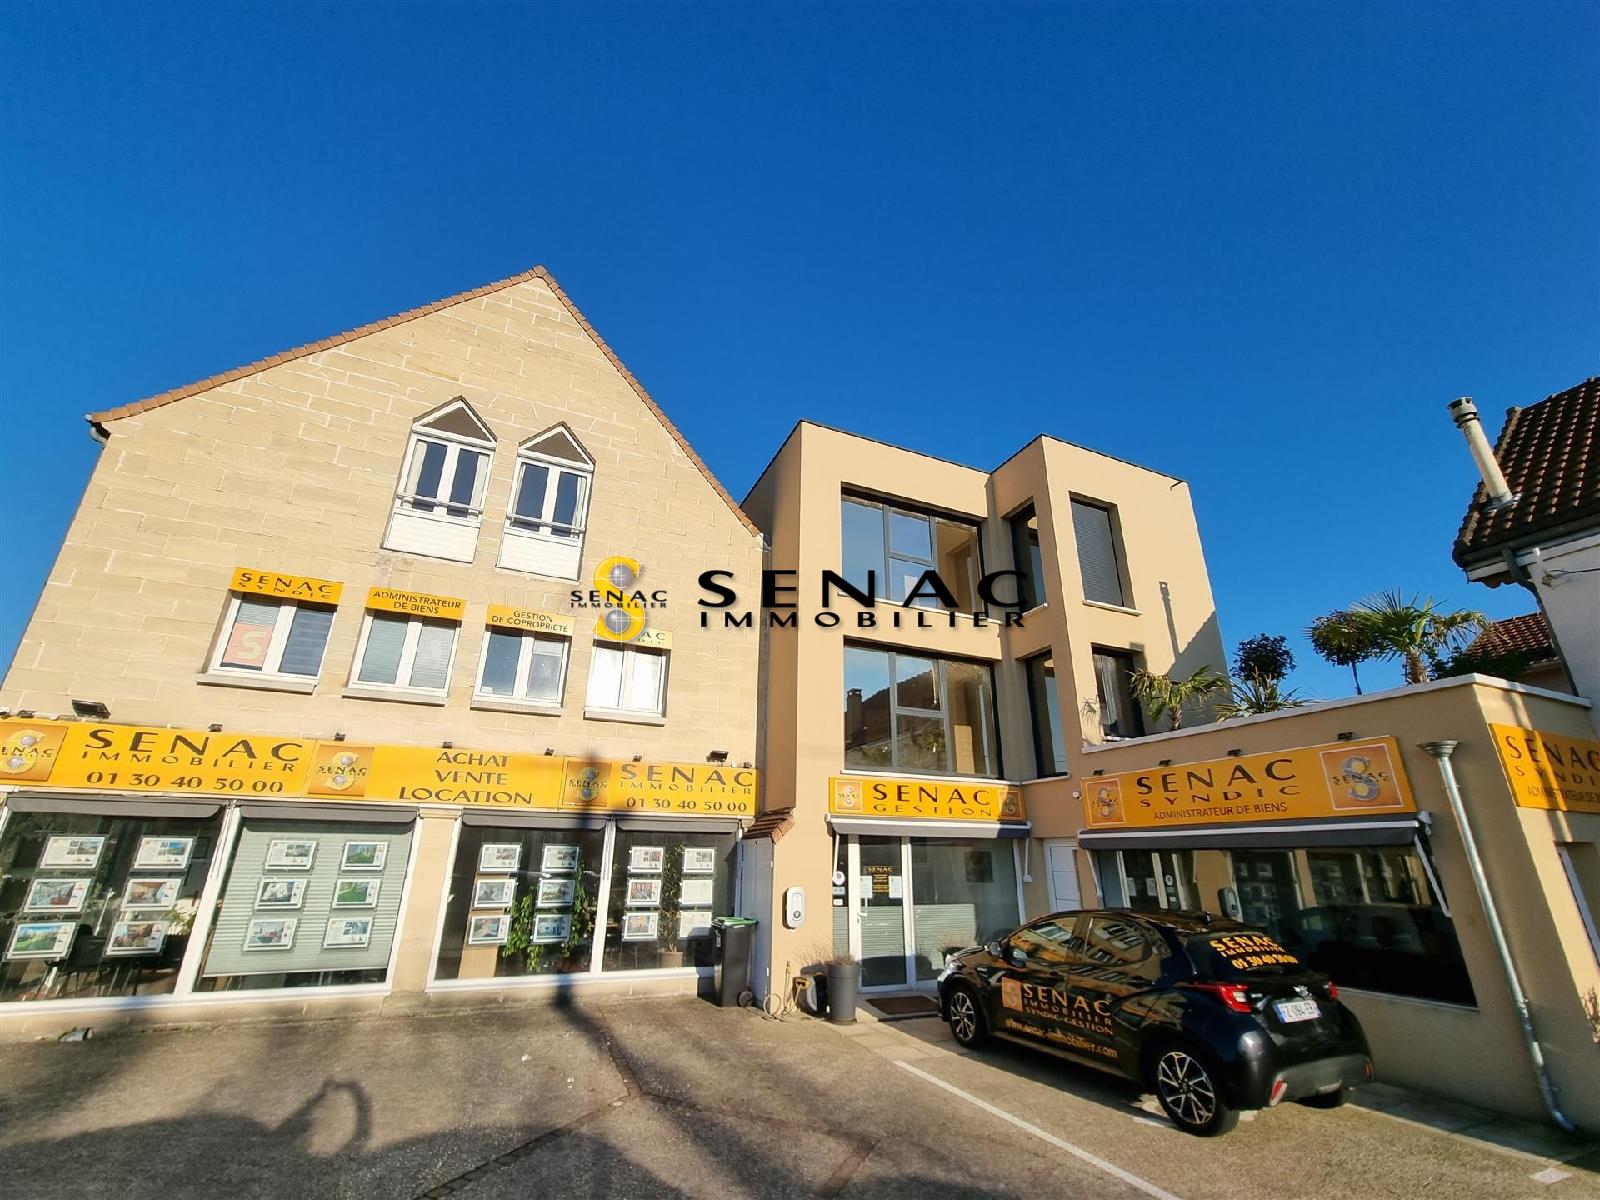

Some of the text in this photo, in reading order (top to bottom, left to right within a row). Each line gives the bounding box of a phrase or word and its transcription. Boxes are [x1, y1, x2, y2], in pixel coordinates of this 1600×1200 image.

[240, 572, 333, 594] SENAC
[373, 590, 461, 609] ADMINISTRATEUR
[393, 601, 440, 614] DE BIENS
[491, 615, 504, 623] DE
[513, 611, 553, 622] GESTION
[1, 746, 54, 755] ENAC
[85, 728, 303, 762] SENAC
[1505, 735, 1600, 772] SENAC
[81, 751, 296, 772] IMMOBILIER
[436, 751, 511, 768] ACHAT
[86, 771, 284, 793] 01 30 40 50 00
[435, 769, 508, 786] VENTE
[620, 763, 753, 788] SENAC
[1136, 759, 1297, 795] SENAC
[1515, 765, 1596, 786] SYNDI
[399, 786, 533, 805] LOCATION
[620, 781, 752, 795] IMMOBILIER
[872, 783, 990, 806] SENAC
[1139, 785, 1301, 808] SYNDIC
[626, 797, 747, 812] 01 30 40 50 00
[873, 803, 992, 817] GESTION
[1153, 802, 1288, 820] ADMINISTRATEUR DE BIENS
[1209, 936, 1278, 952] SENAC
[1023, 983, 1112, 1016] SENAC
